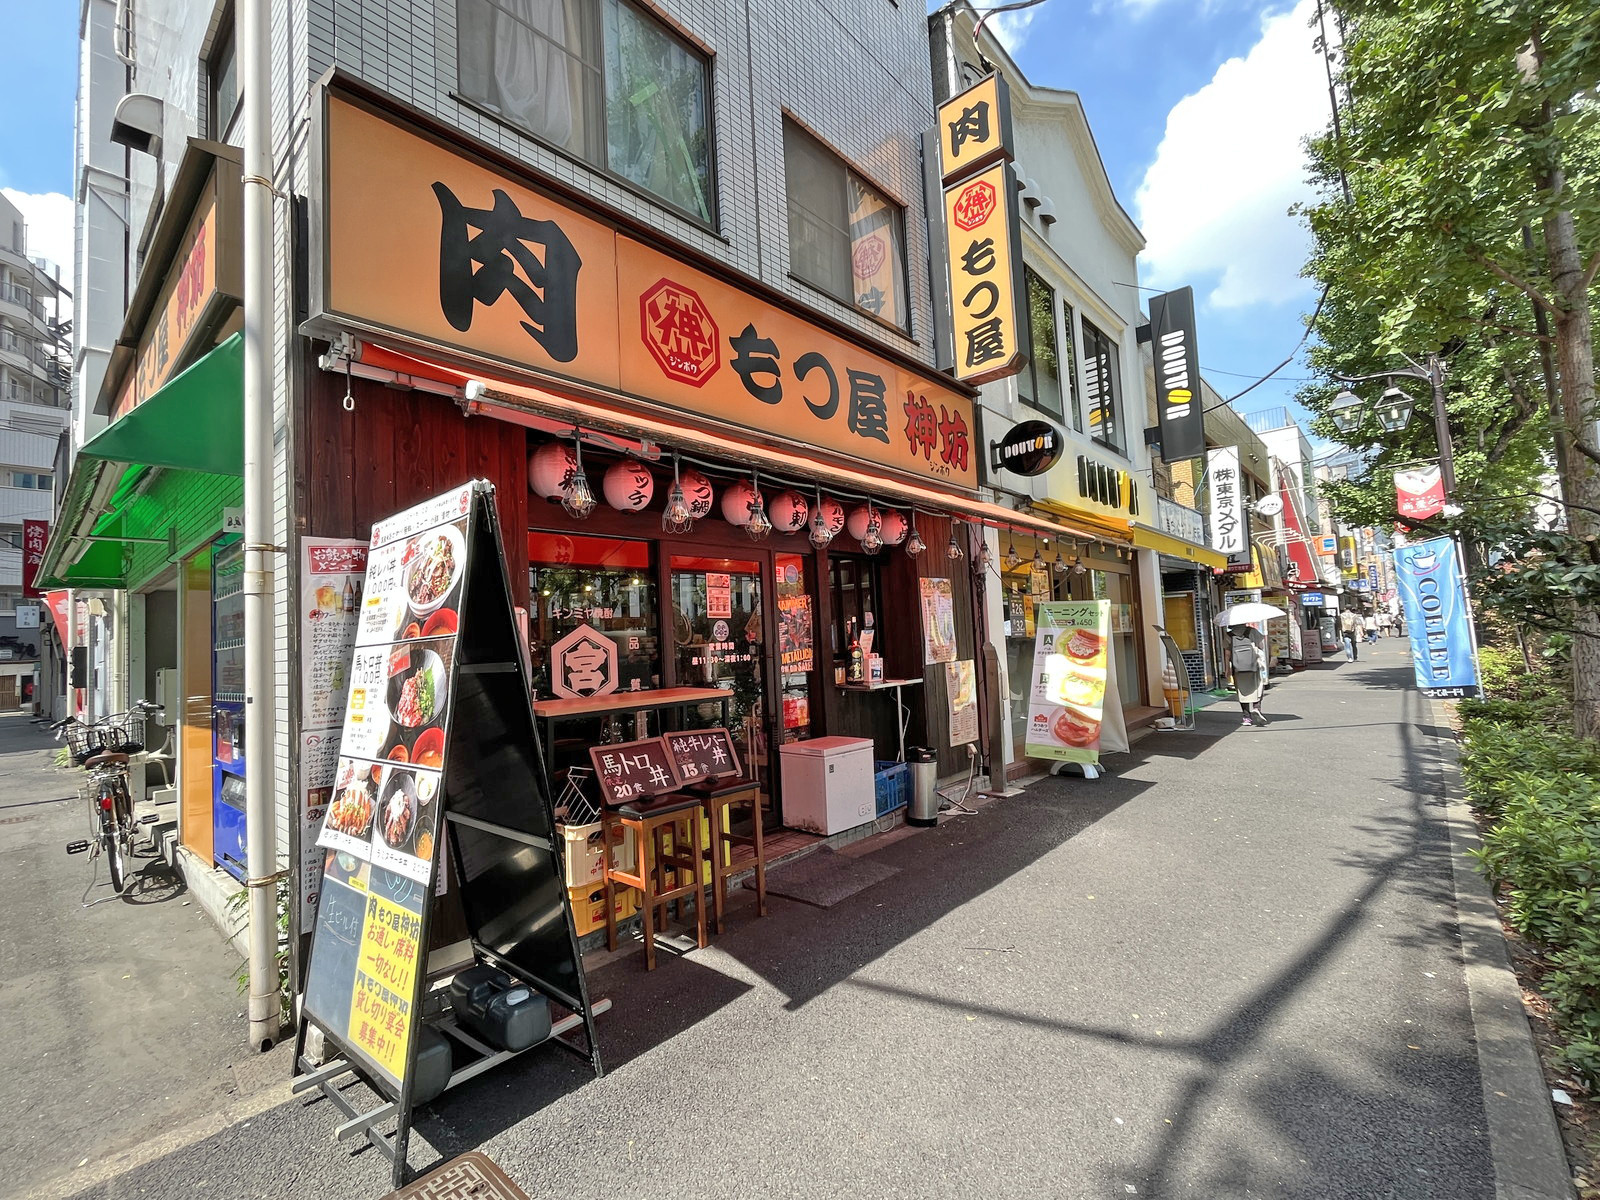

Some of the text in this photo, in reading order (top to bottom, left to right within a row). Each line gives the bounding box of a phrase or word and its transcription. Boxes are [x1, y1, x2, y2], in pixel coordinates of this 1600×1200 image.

[949, 101, 990, 157] 肉
[431, 181, 582, 362] 肉
[729, 323, 890, 445] もつ屋
[904, 389, 970, 472] 神坊
[960, 237, 1006, 368] もつ屋
[1161, 328, 1192, 421] DOUTOR
[1004, 435, 1053, 459] DOUTOR
[318, 561, 358, 572] メニュー
